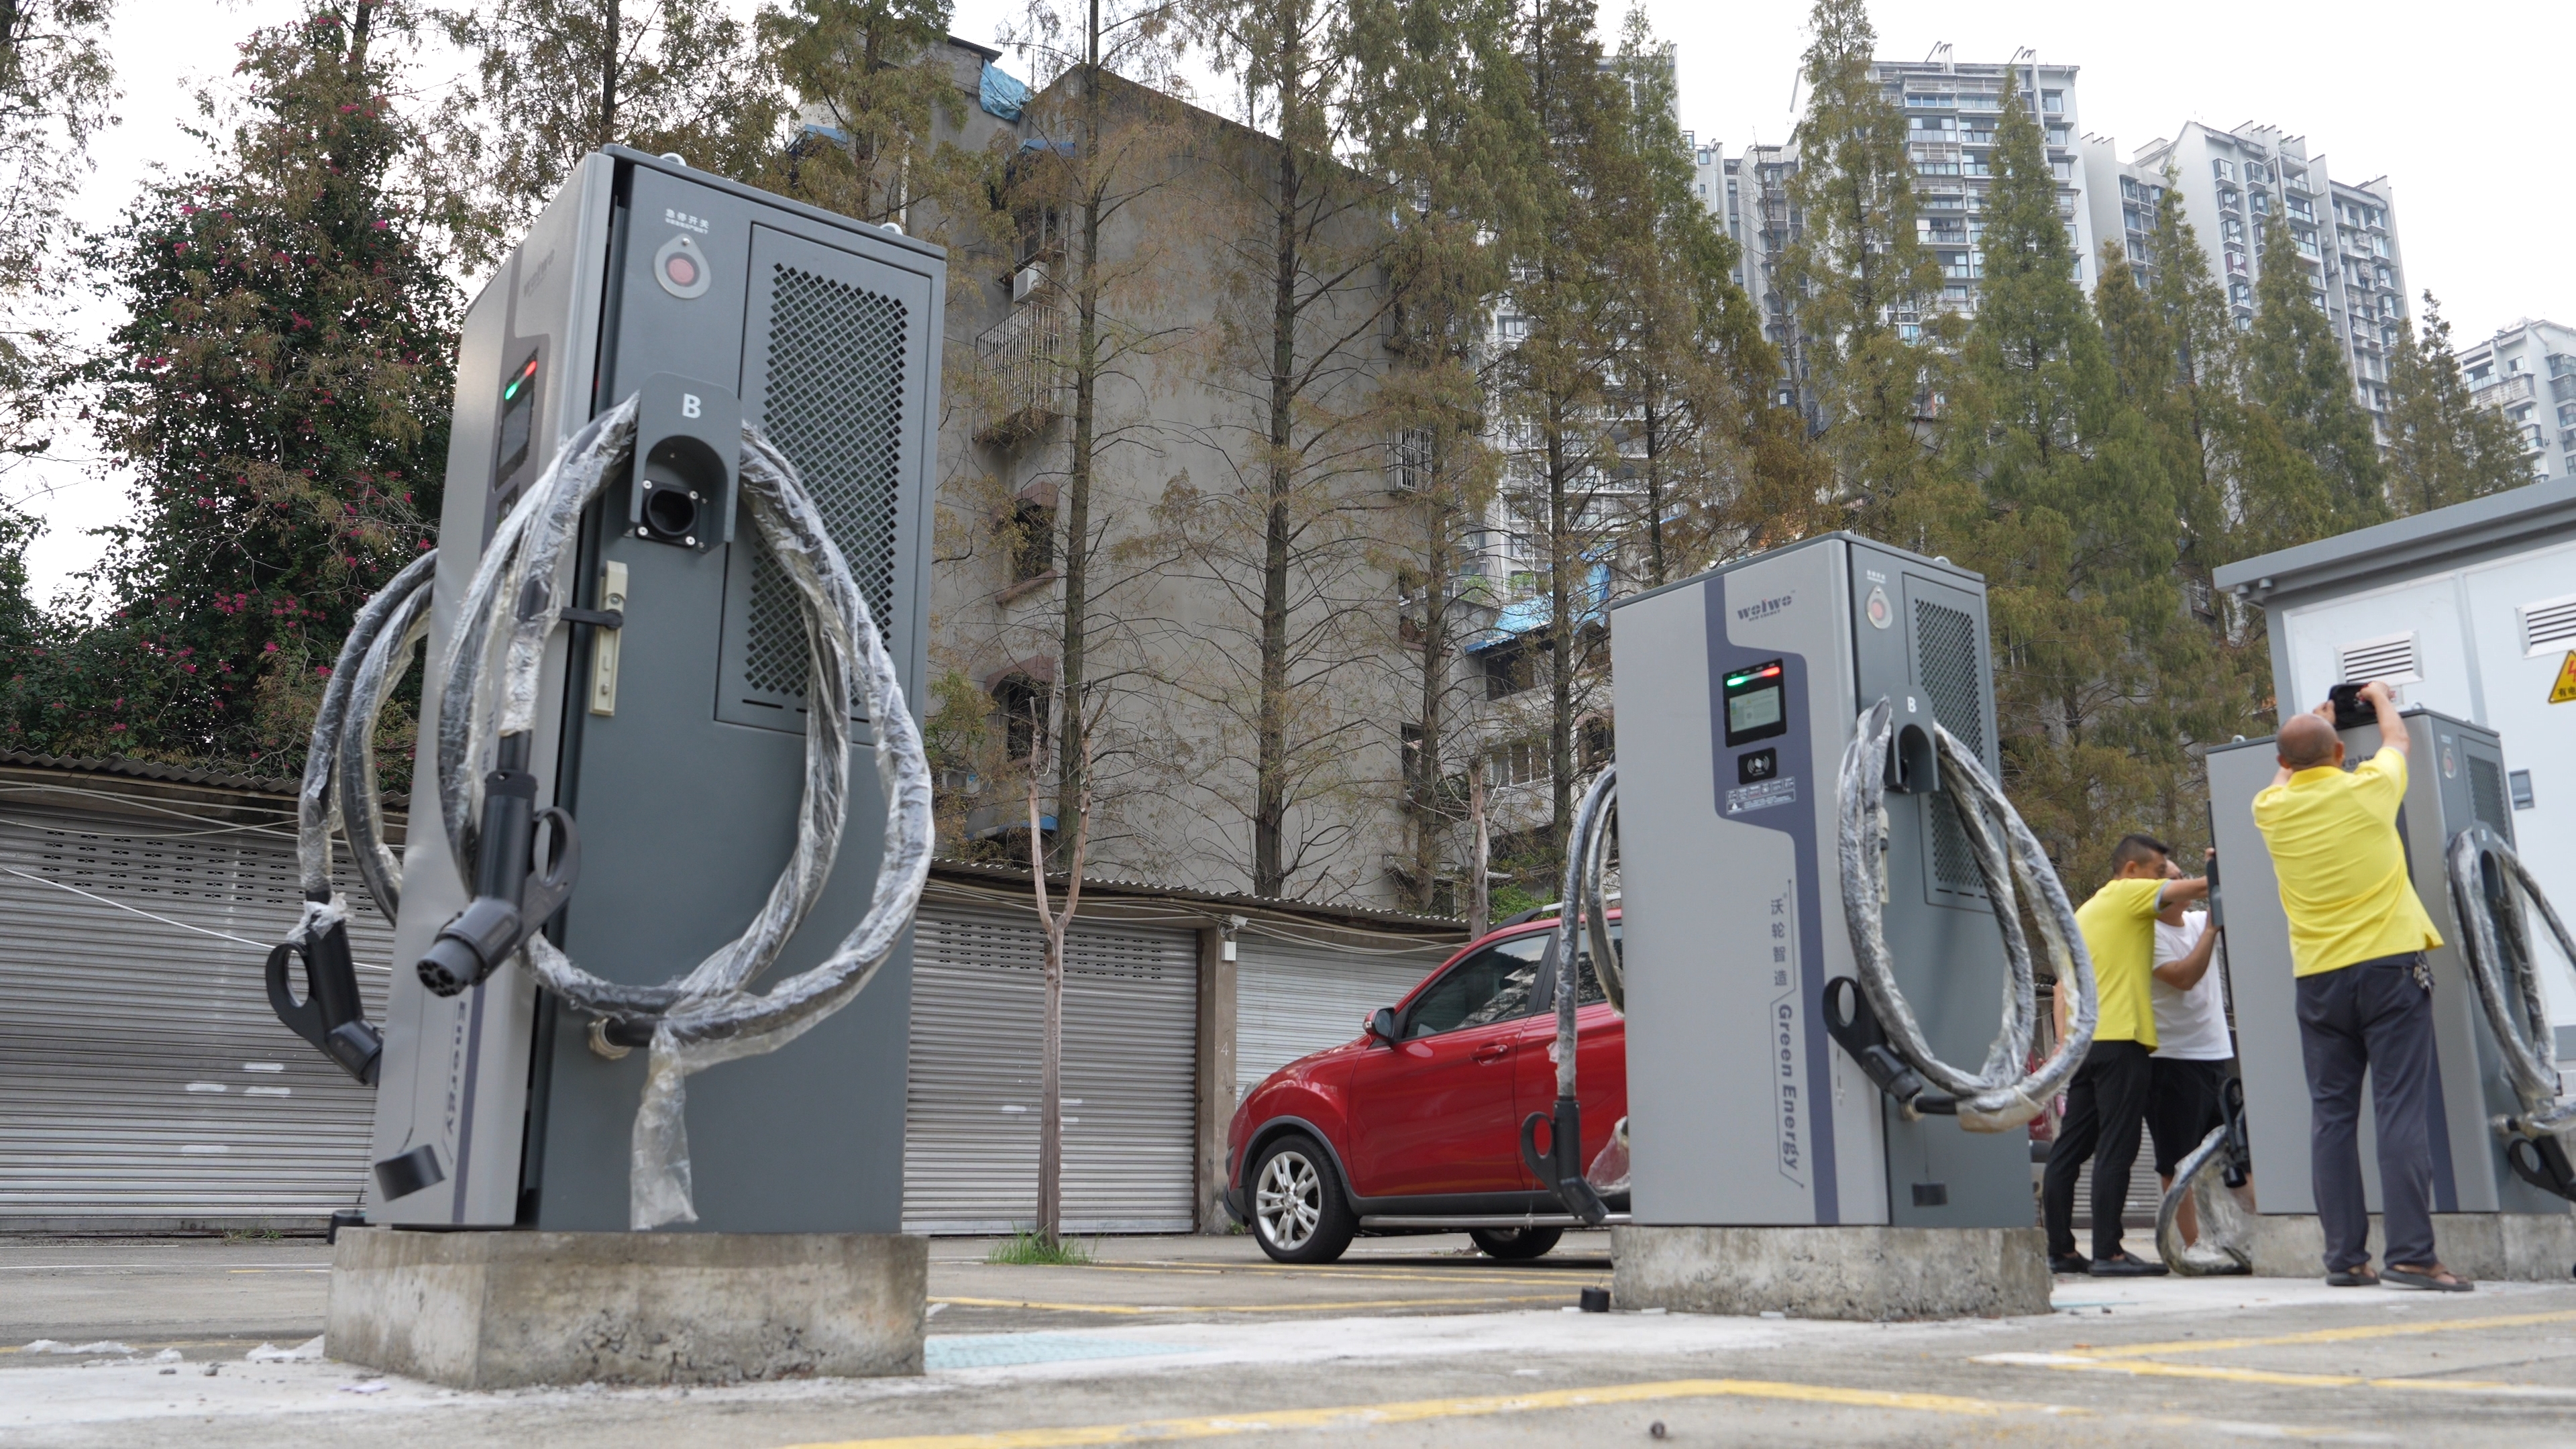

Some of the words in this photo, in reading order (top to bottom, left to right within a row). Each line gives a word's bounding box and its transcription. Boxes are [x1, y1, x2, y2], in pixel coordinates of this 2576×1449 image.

[682, 393, 701, 419] B
[1907, 696, 1917, 713] B
[1771, 898, 1787, 986] 沃轮智造
[1778, 1004, 1792, 1077] Green
[1782, 1084, 1799, 1170] Energy
